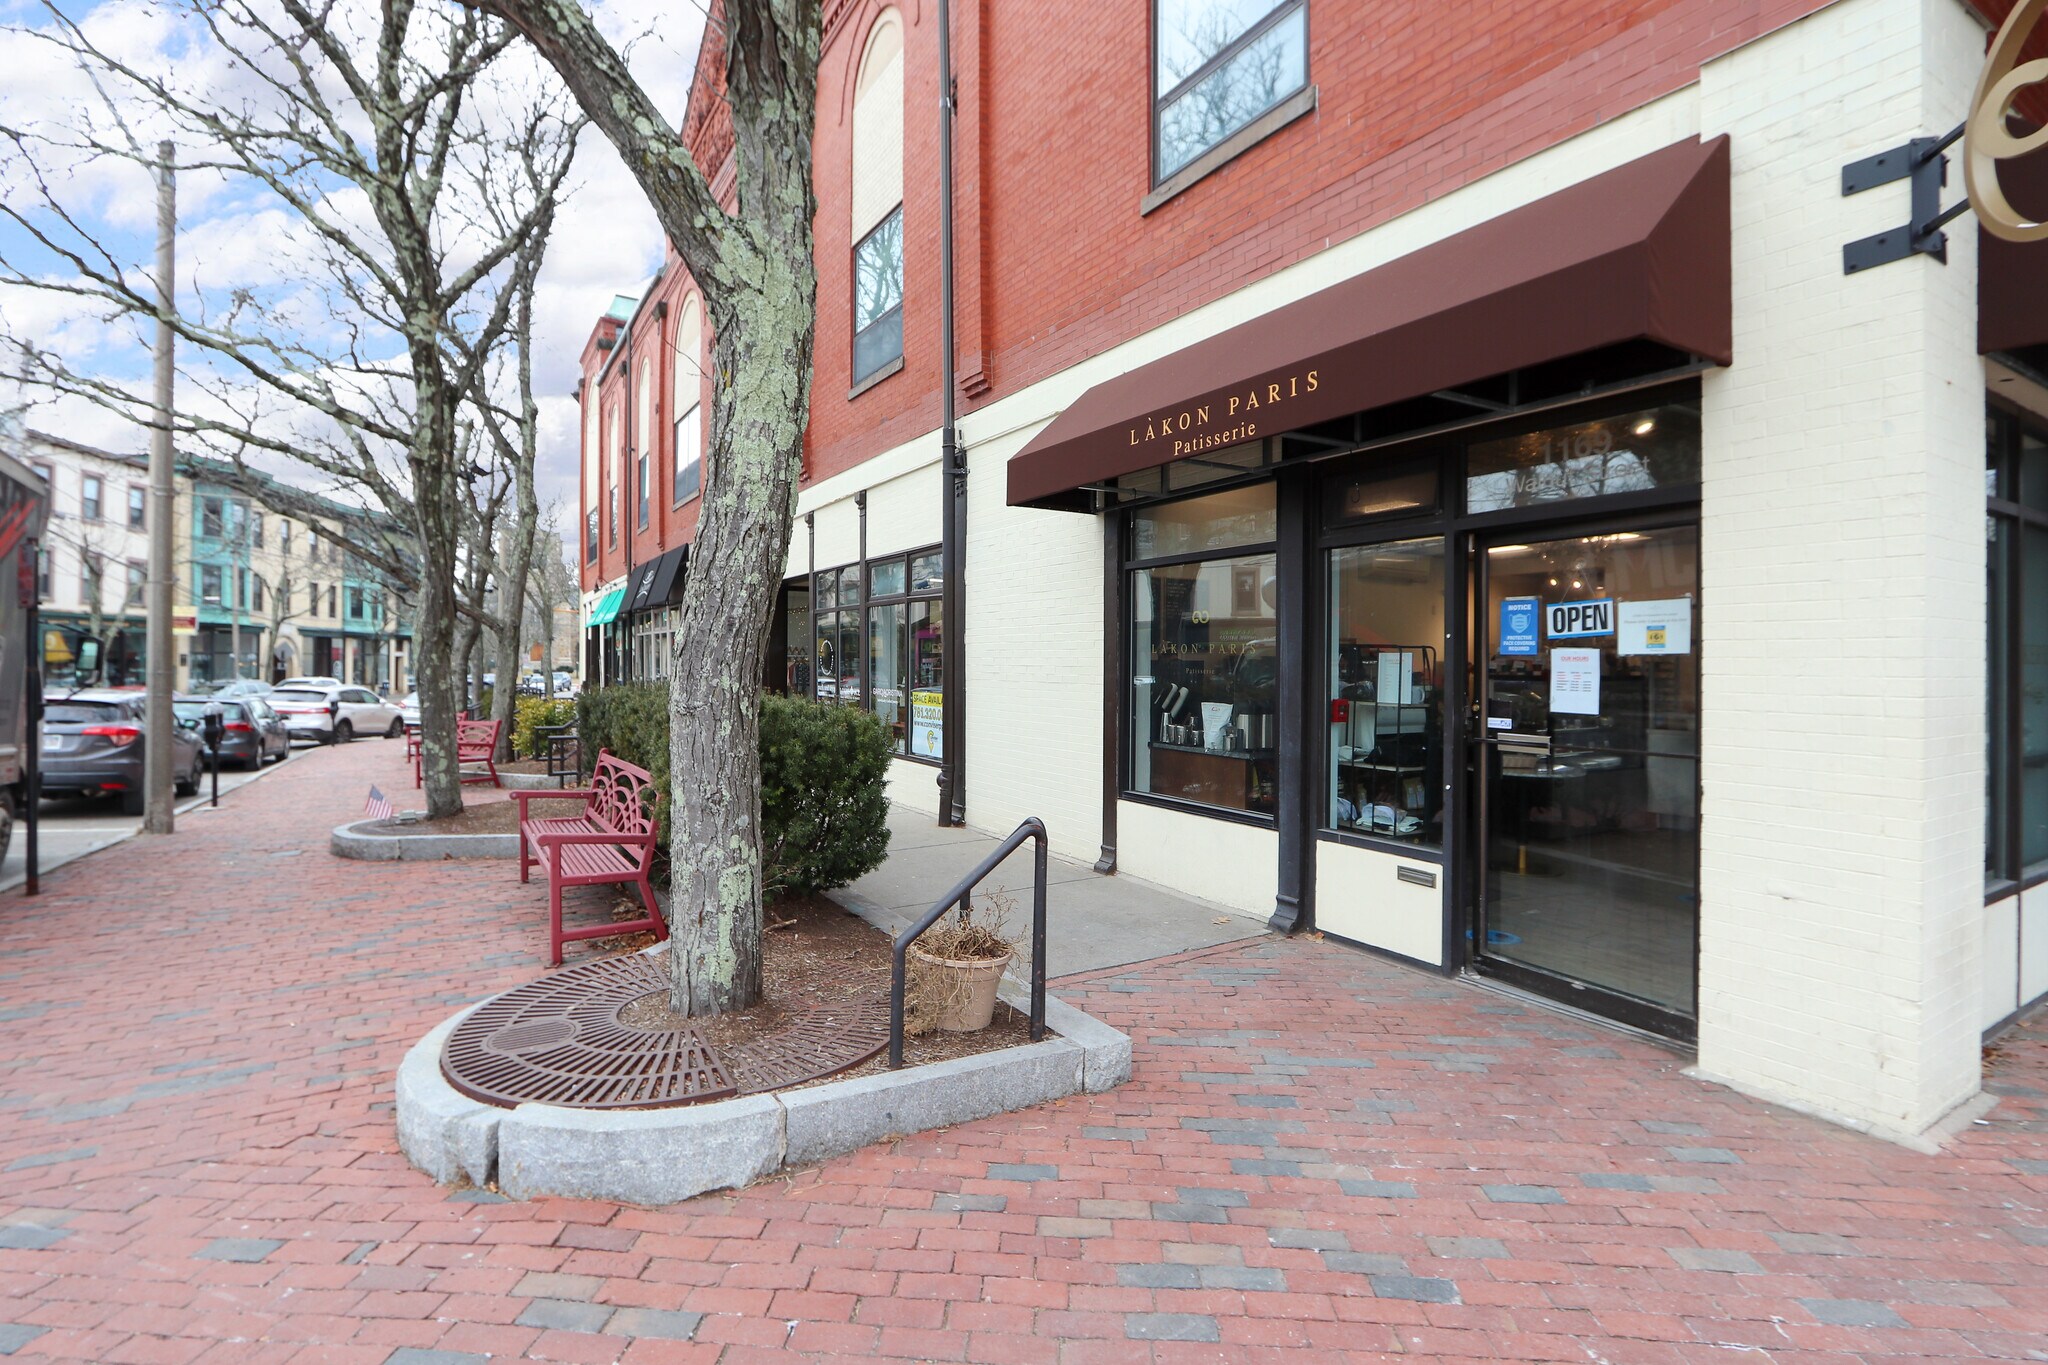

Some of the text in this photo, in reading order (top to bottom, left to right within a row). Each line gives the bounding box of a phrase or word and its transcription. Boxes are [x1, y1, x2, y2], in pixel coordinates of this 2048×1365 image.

[1130, 370, 1319, 446] LÀKON PARIS
[1174, 421, 1257, 456] Patisserie
[1541, 429, 1613, 464] 1169
[1508, 455, 1651, 494] Walnut Street
[1508, 603, 1532, 611] NOTICE
[1552, 603, 1609, 634] OPEN
[1209, 643, 1256, 654] PARIS
[914, 694, 943, 705] SPACE AVAIL
